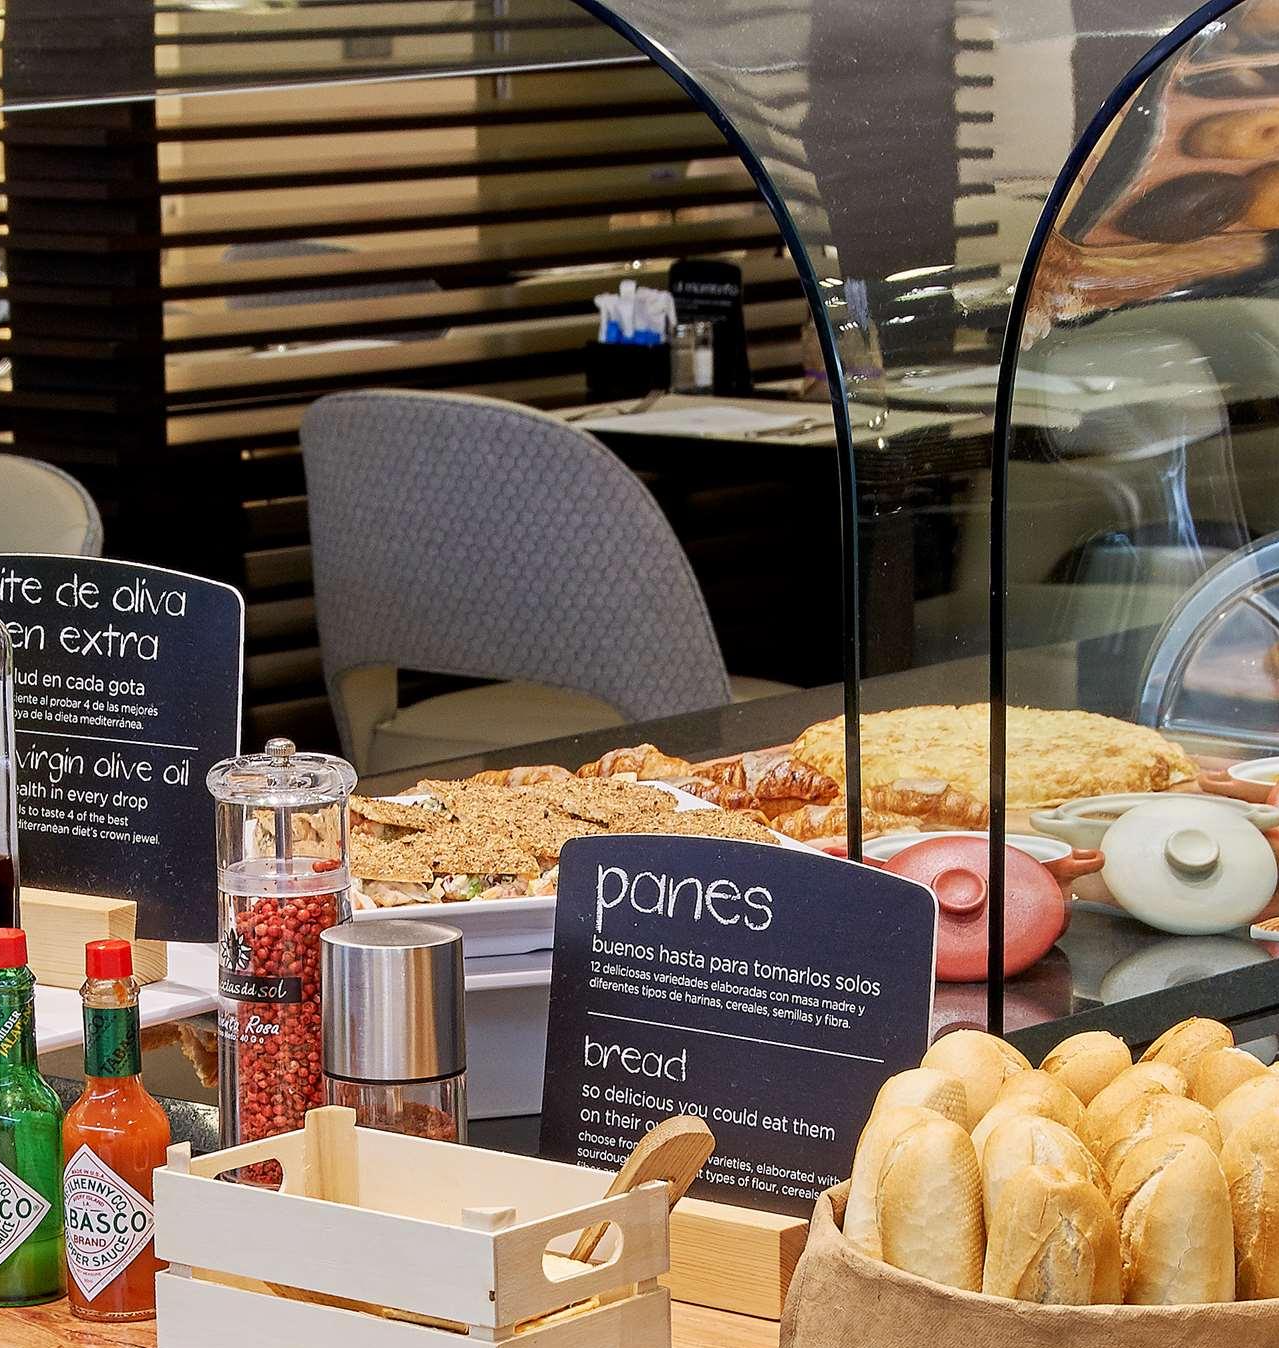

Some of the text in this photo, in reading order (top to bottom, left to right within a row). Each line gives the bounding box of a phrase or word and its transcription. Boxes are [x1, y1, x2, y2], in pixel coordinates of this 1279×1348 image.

[56, 573, 99, 609] de
[112, 577, 187, 617] oliva
[60, 623, 159, 661] extra
[42, 674, 145, 697] en cada gota
[39, 695, 159, 717] al probar 4 de las mejores
[30, 708, 144, 730] de la dieta mediterránea.
[16, 744, 190, 786] virgin olive oil
[51, 784, 148, 812] in every drop
[28, 806, 129, 827] to taste 4 of the best
[72, 825, 160, 845] diet's crown jewel.
[596, 864, 773, 933] panes
[592, 934, 881, 996] buenos hasta para tomarlos solos
[257, 979, 287, 998] sol
[590, 961, 866, 1017] 12 deliciosas variedades elaboradas con masa madre y
[589, 977, 851, 1030] diferentes tipos de harinas, cereales, semillas y fibra.
[245, 1015, 280, 1035] Rosa
[240, 1034, 249, 1042] 40
[584, 1035, 687, 1082] bread
[580, 1108, 601, 1123] on
[605, 1108, 642, 1132] their
[581, 1084, 836, 1141] so delicious you could eat them
[578, 1130, 616, 1147] choose
[707, 1156, 753, 1173] varieties,
[757, 1163, 814, 1182] elaborated
[706, 1170, 734, 1184] types
[738, 1173, 749, 1186] of
[751, 1178, 779, 1194] flour,
[73, 1234, 107, 1248] BRAND
[92, 1235, 129, 1267] SAUCE
